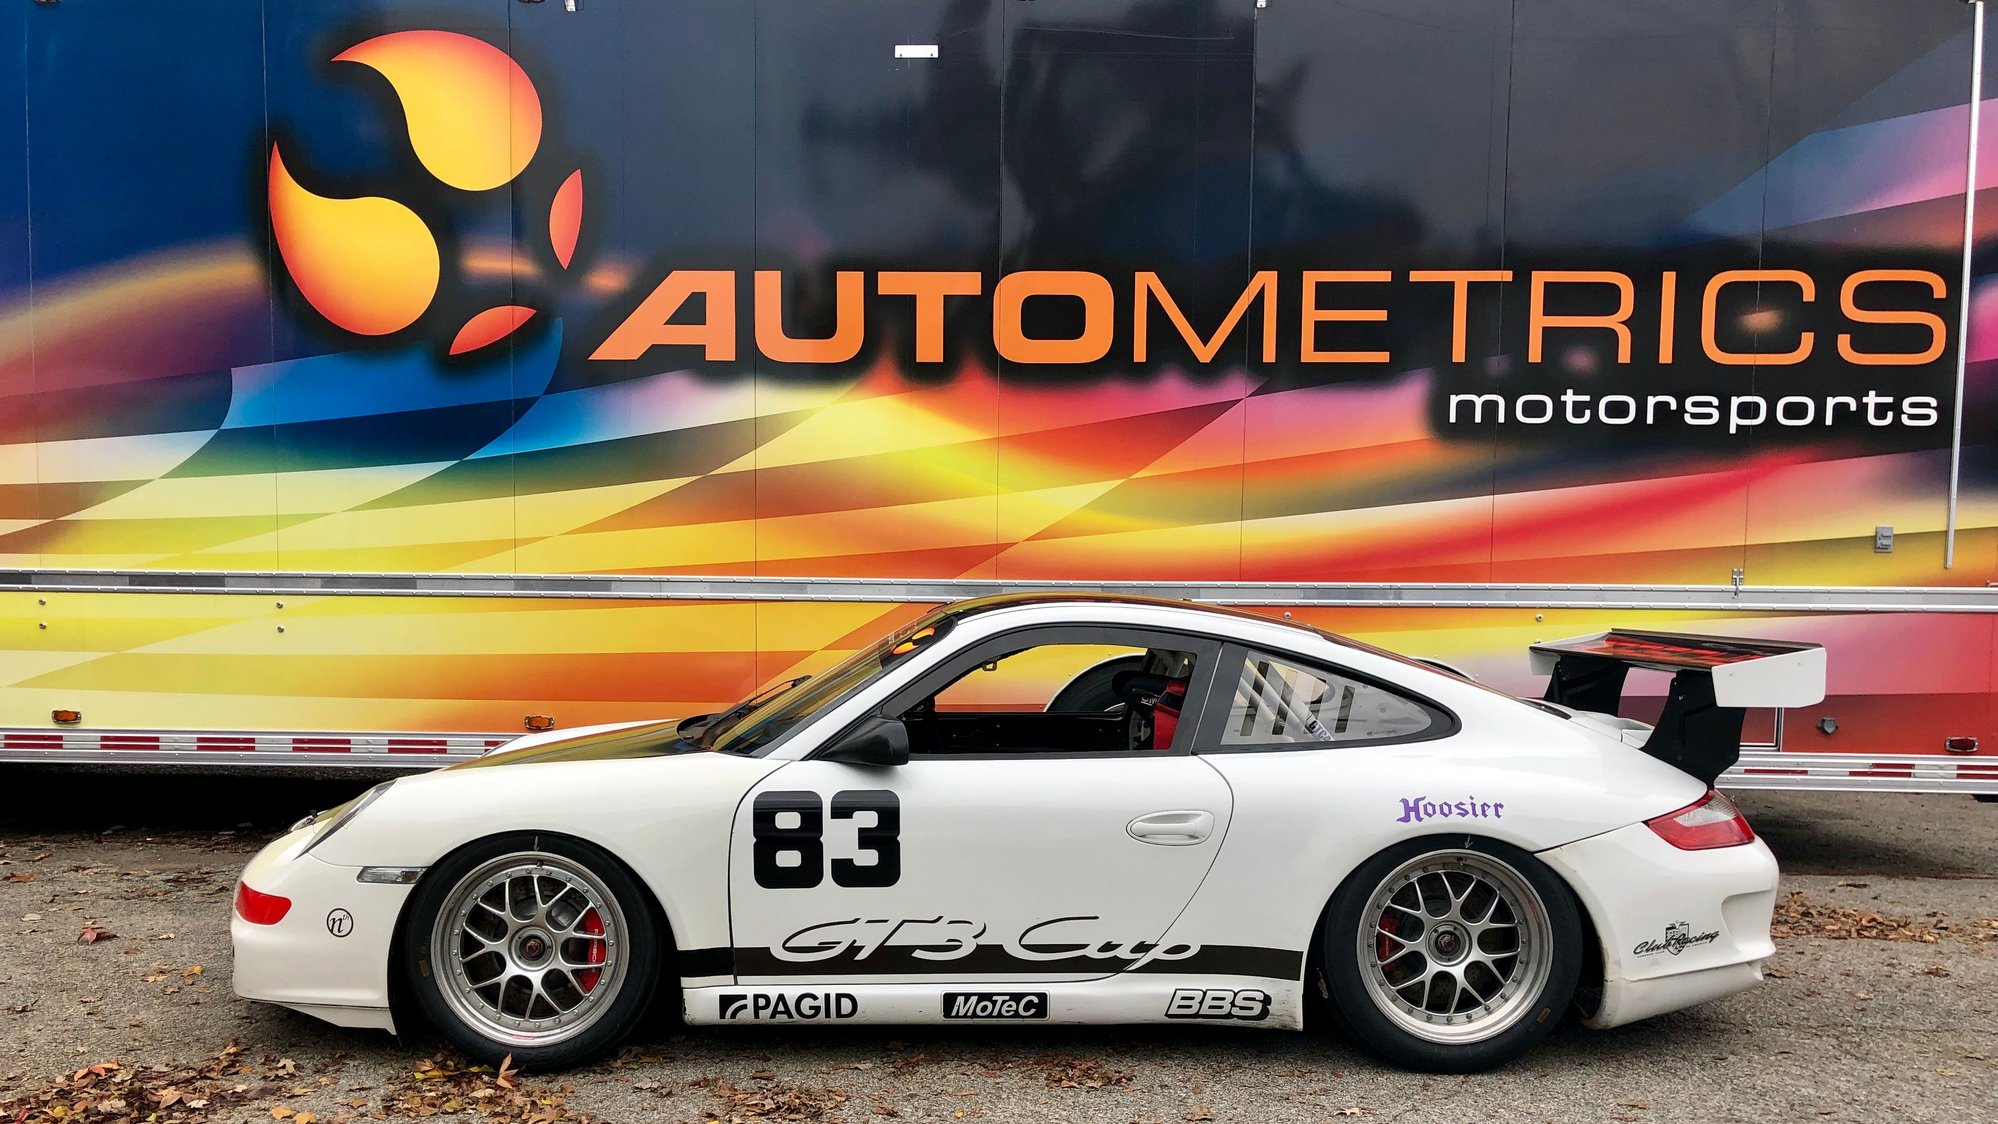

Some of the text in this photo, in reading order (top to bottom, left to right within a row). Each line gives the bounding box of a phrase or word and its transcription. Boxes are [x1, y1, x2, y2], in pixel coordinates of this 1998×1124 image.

[588, 269, 1948, 366] AUTOMETRICS
[1448, 388, 1940, 434] motorsports
[1396, 795, 1505, 823] Hoosier
[753, 790, 901, 889] 83
[769, 915, 1201, 972] GT3 Cup
[753, 992, 859, 1020] PAGID
[950, 995, 1039, 1017] MoTeC
[1164, 988, 1273, 1021] BBS
